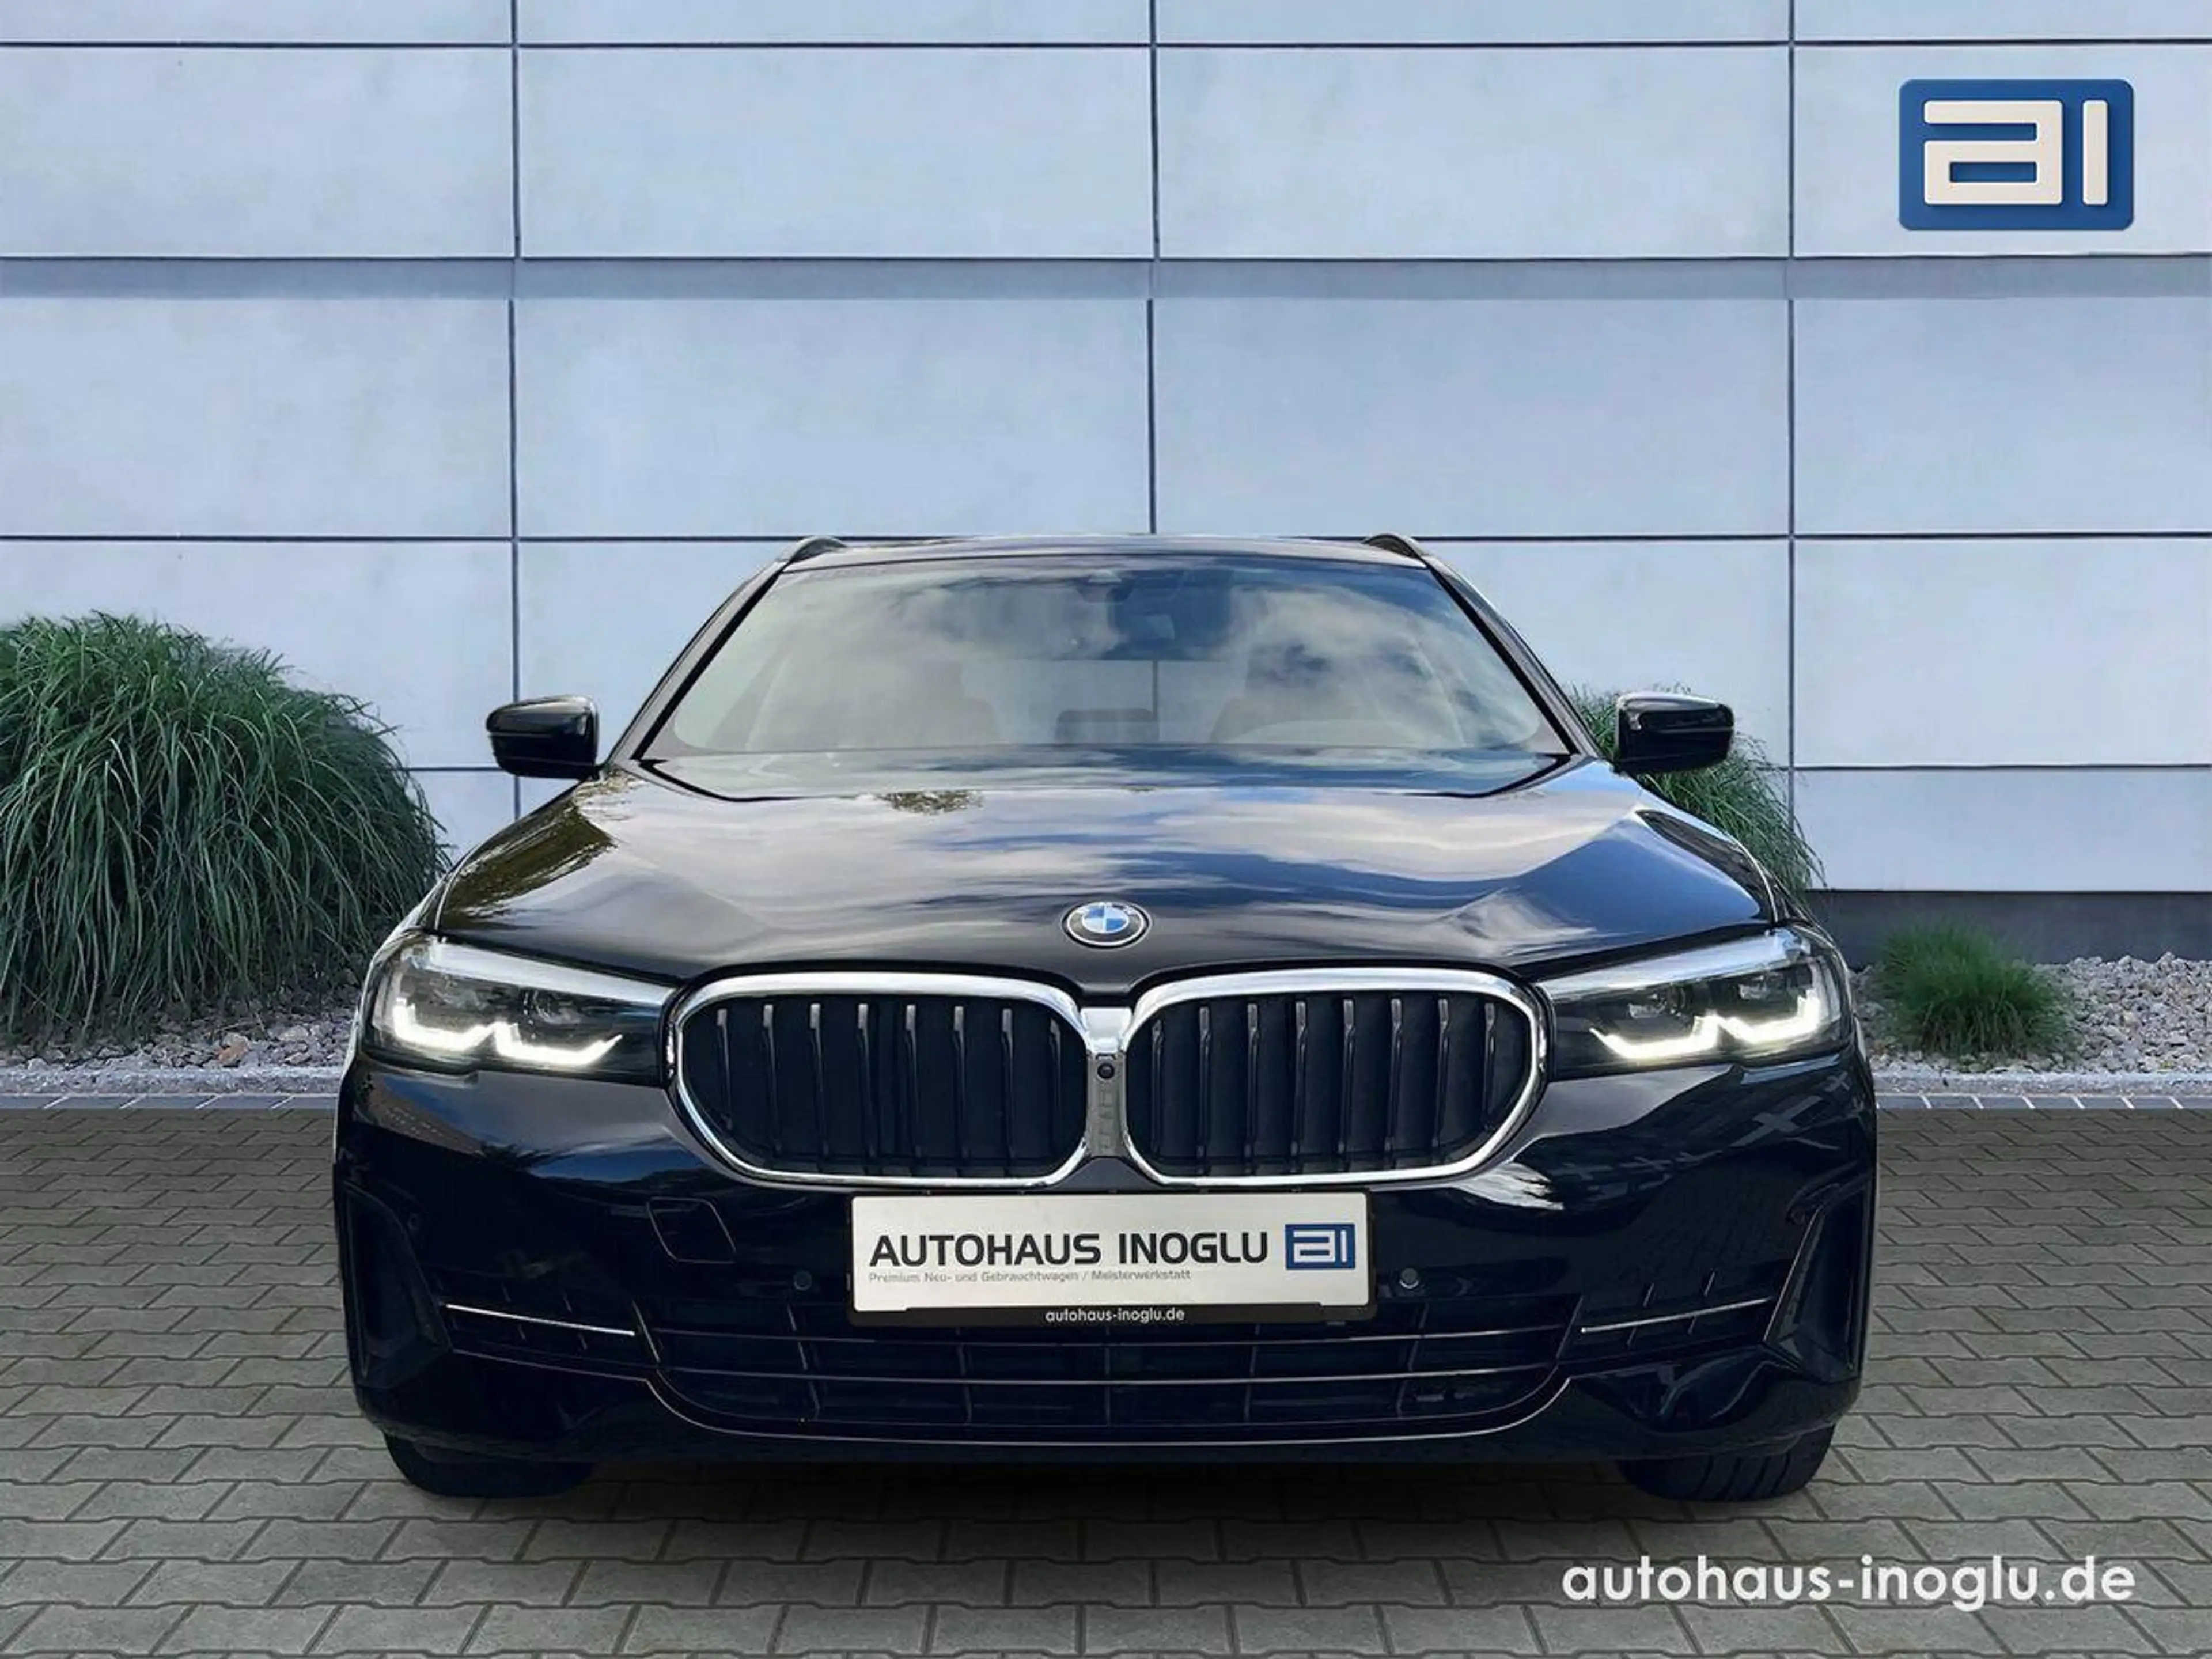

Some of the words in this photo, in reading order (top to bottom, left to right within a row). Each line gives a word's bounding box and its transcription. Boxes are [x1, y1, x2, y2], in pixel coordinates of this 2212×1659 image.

[869, 1233, 1101, 1267] AUTOHAUS
[1119, 1232, 1267, 1264] INOGLU
[869, 1273, 921, 1283] Premium
[955, 1271, 978, 1282] und
[981, 1270, 1079, 1282] Gebrauchtwagen
[1091, 1268, 1191, 1280] Meisterwerkstatt
[1045, 1307, 1185, 1324] autohaus-inoglu.de
